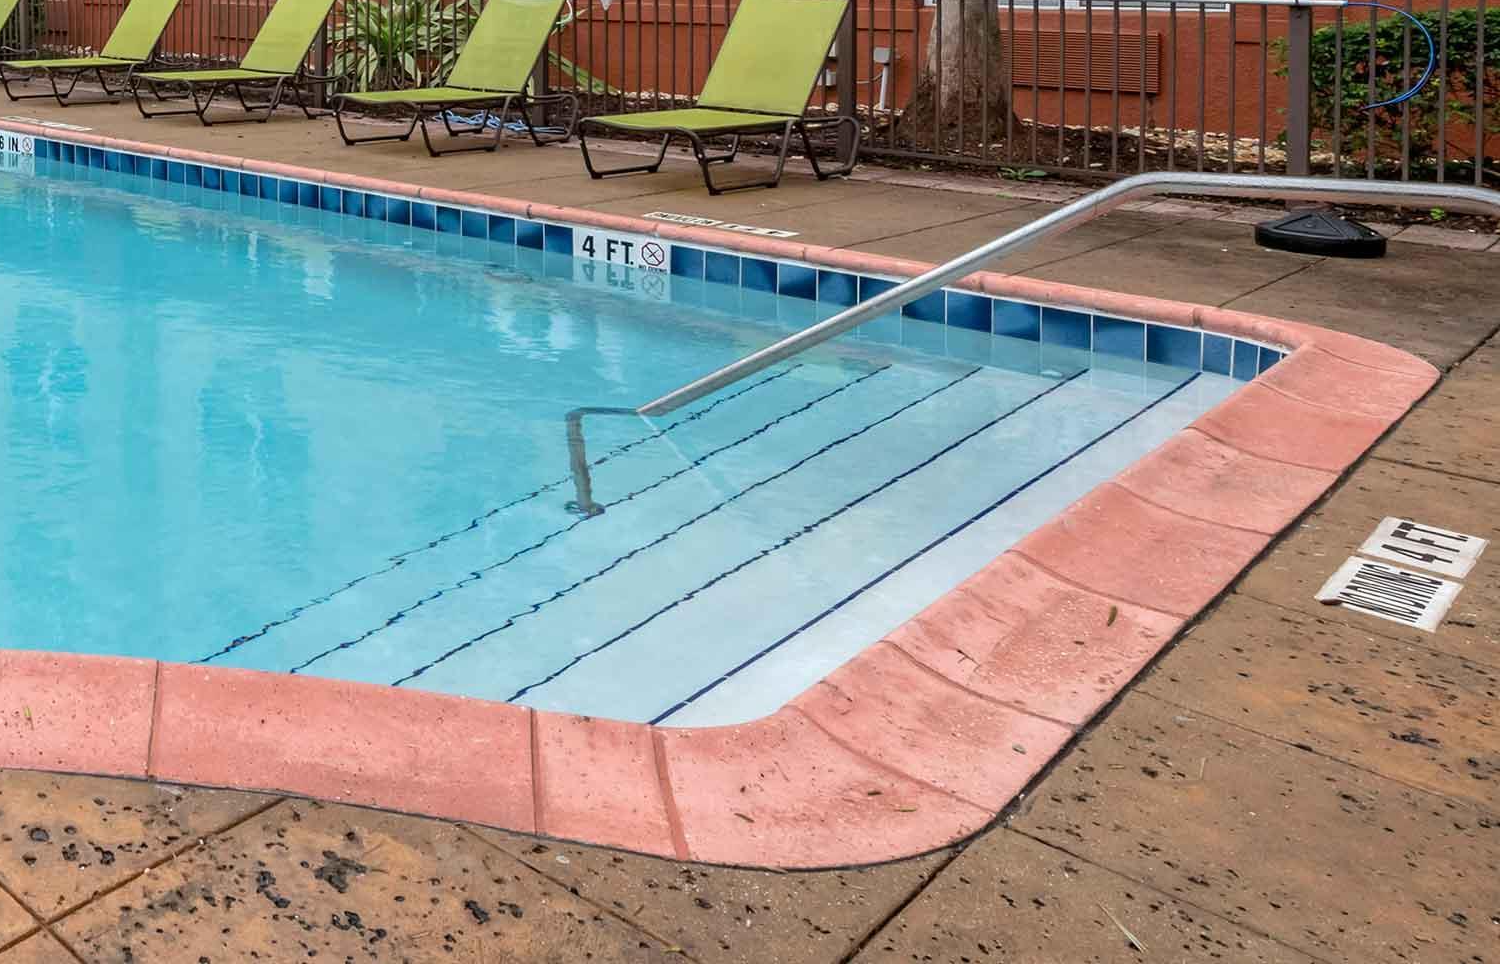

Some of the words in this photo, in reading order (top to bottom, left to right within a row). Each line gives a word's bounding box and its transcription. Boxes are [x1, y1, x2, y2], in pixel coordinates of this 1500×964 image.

[582, 235, 596, 258] 4
[606, 238, 635, 266] FT.
[1381, 543, 1453, 563] 4
[1390, 522, 1469, 553] FT.
[1345, 563, 1443, 610] DIVING
